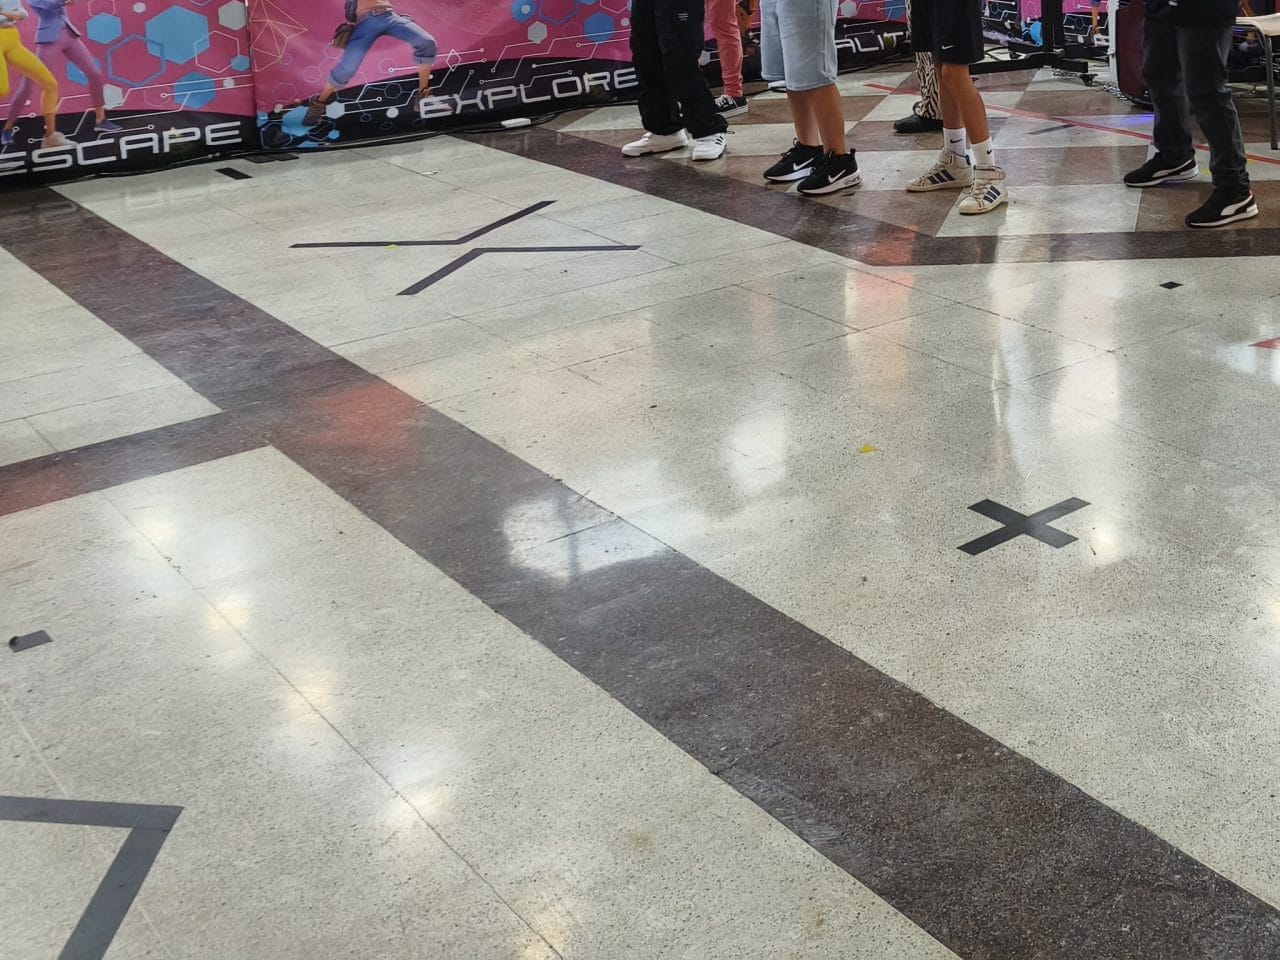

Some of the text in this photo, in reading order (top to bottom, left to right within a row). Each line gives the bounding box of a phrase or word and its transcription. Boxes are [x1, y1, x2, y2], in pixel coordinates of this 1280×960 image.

[836, 31, 911, 54] ALIT
[419, 67, 639, 118] EXPLORE
[0, 121, 242, 176] ESCAPE
